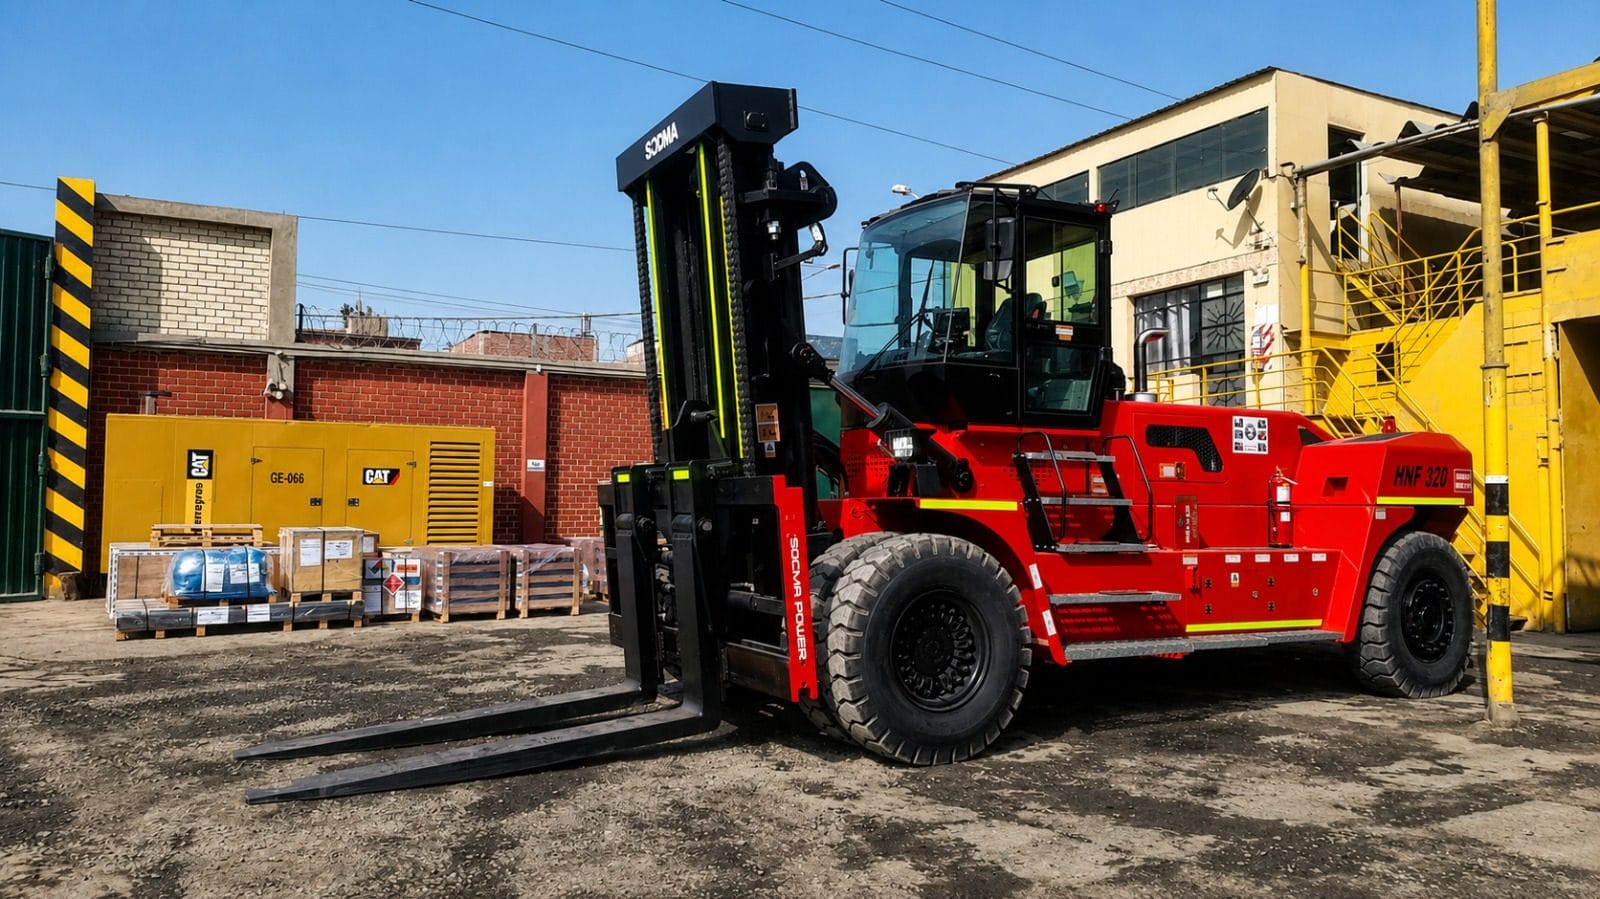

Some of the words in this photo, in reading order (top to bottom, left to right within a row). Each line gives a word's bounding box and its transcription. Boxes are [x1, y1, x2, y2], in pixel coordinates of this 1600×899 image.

[191, 451, 210, 477] CAT
[270, 472, 305, 484] GE-066
[365, 469, 391, 484] CAT
[1393, 465, 1422, 487] HNF
[1425, 466, 1449, 488] 320
[789, 537, 802, 598] SOCMA
[794, 601, 807, 661] POWER
